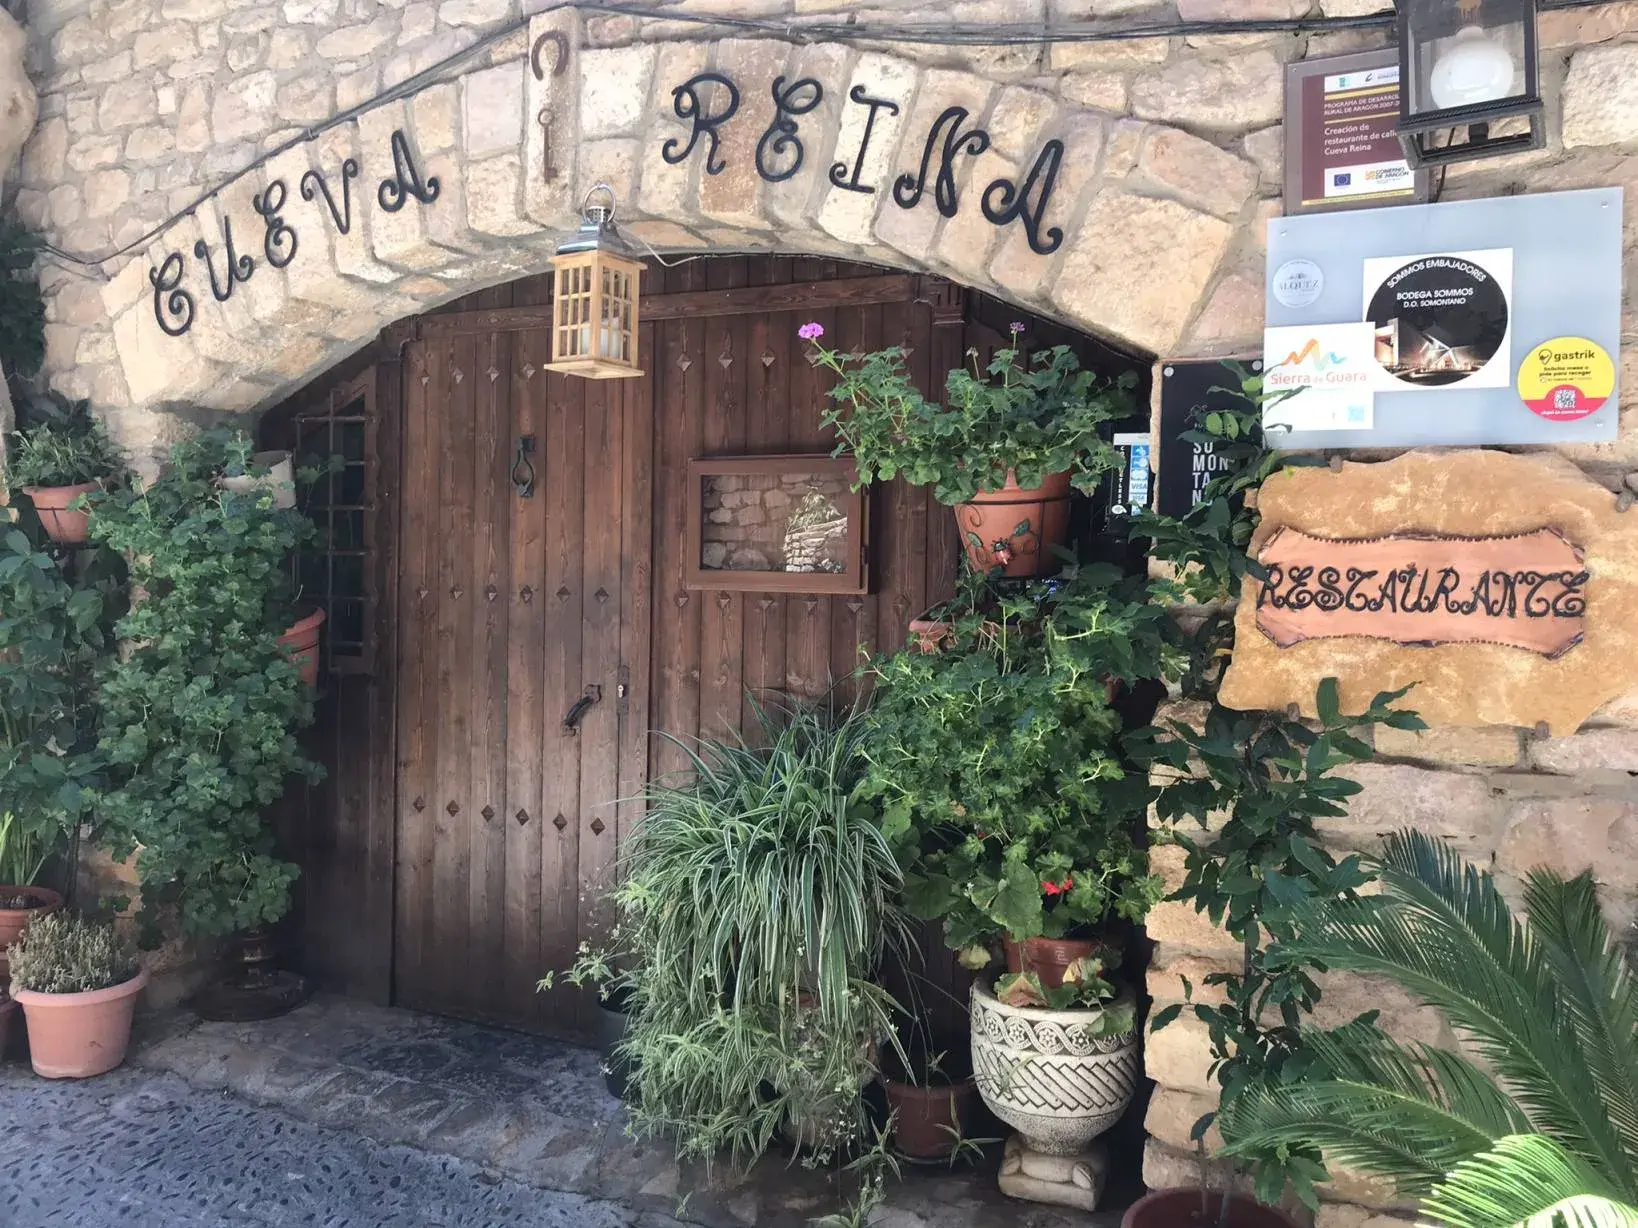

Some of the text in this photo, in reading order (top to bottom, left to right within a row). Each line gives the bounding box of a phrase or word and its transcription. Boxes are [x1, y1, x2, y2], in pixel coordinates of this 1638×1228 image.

[1324, 123, 1370, 136] Creación de
[1324, 134, 1368, 145] restaurante
[1369, 132, 1380, 140] de
[1324, 144, 1372, 156] Cueva Reina
[149, 72, 1064, 337] CUEVA REINA
[1386, 259, 1487, 289] SOMMOS EMBAJADORES
[1396, 287, 1474, 301] BODEGA SOMMOS
[1420, 298, 1467, 307] SOMONTANO
[1554, 350, 1595, 362] gastrik
[1270, 373, 1311, 386] Sierra
[1325, 371, 1368, 383] Guara
[1191, 489, 1213, 507] N
[1256, 562, 1590, 618] RESTAURANTE
